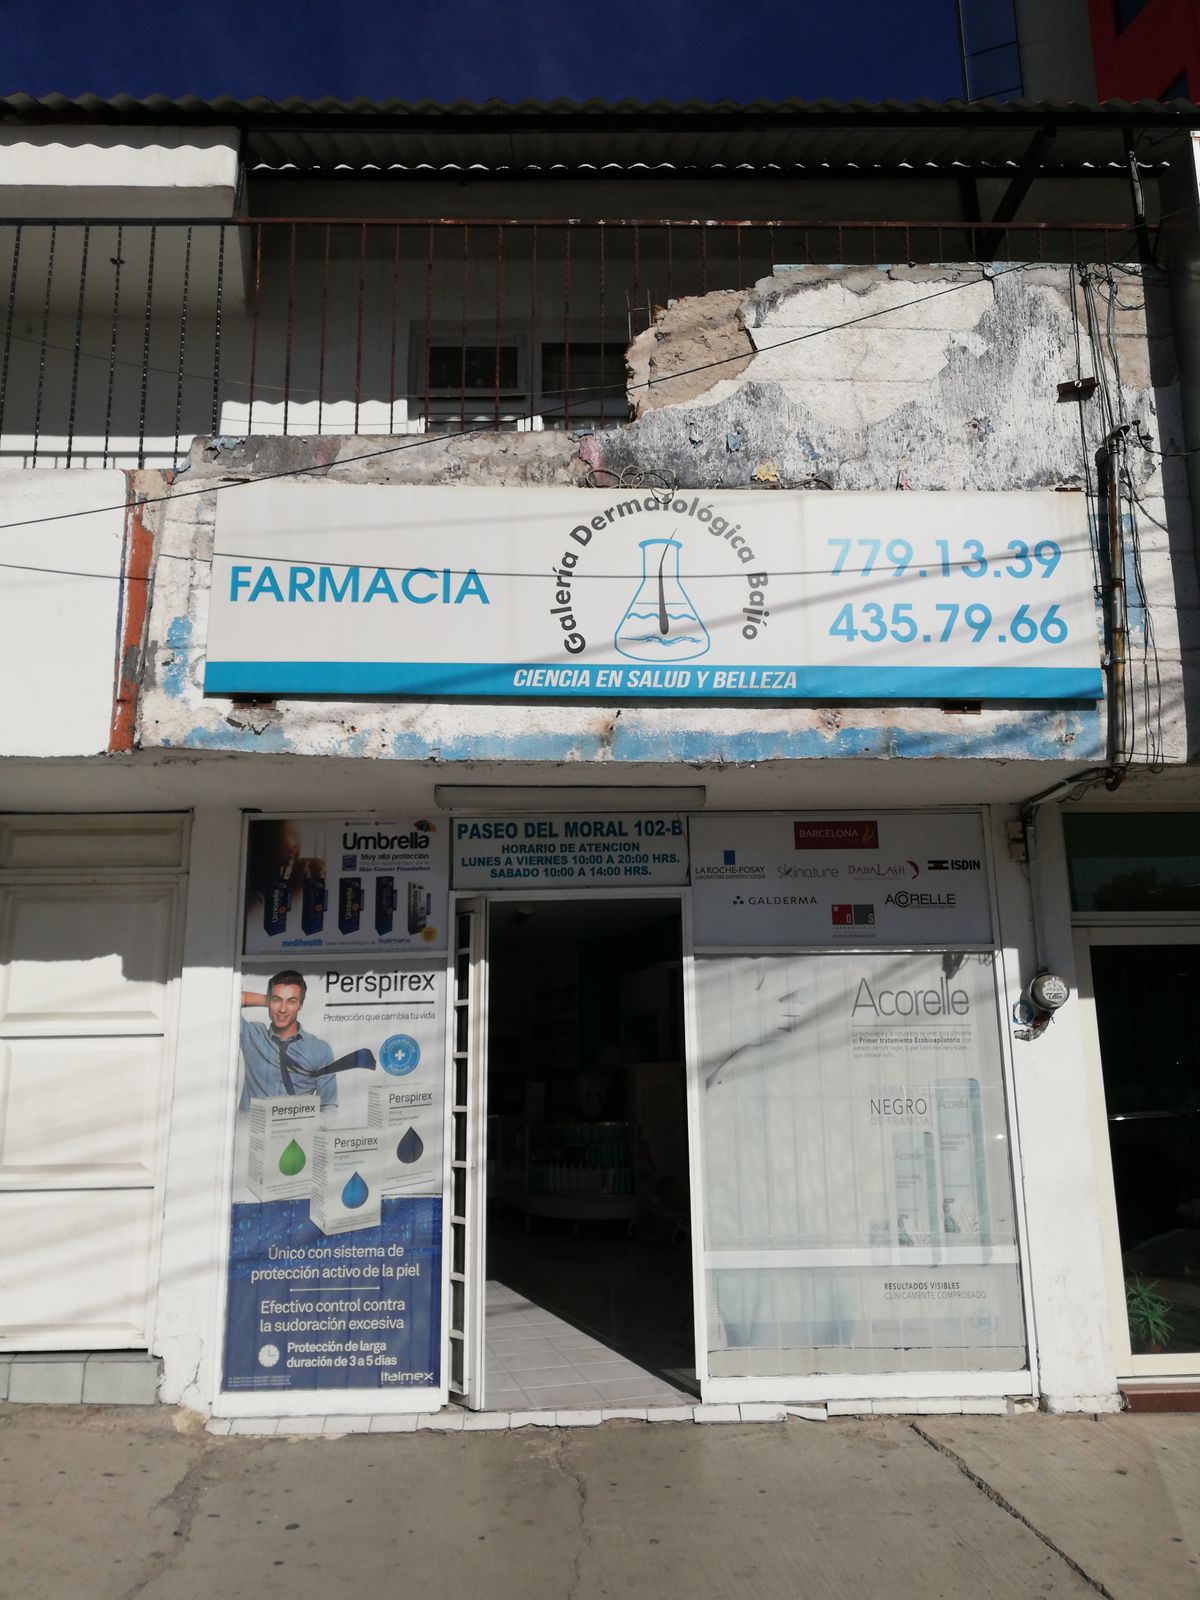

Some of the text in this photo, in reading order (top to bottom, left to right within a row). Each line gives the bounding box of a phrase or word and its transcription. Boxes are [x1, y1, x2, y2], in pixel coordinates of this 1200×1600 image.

[827, 538, 1062, 579] 779.13.39
[550, 494, 771, 655] Galería Dermatológica Bajío
[229, 566, 491, 604] FARMACIA
[828, 602, 1068, 644] 435.79.66
[513, 669, 797, 689] CIENCIA EN SALUD Y BELLEZA
[457, 820, 684, 839] PASEO DEL MORAL 102-B
[799, 829, 859, 838] BARCELONA
[342, 832, 430, 850] Umbrella
[501, 842, 640, 854] HORARIO DE ATENCION
[360, 853, 377, 861] Muy
[461, 853, 681, 867] LUNES A VIERNES 10:00 A 20:00 HRS.
[490, 866, 652, 878] SABADO 10:00 A 14:00 HRS.
[706, 866, 766, 874] ROCHE-POSAY
[951, 860, 981, 871] ISDIN
[748, 896, 817, 905] GALDERMA
[325, 970, 435, 998] Perspirex
[851, 976, 970, 1017] Acorelle
[323, 1011, 435, 1023] Protección que cambia tu vida
[859, 1036, 878, 1044] Primer
[879, 1036, 913, 1044] tratamiento
[389, 1091, 432, 1104] Perspirex
[271, 1104, 315, 1117] Perspirex
[870, 1098, 927, 1115] NEGRO
[334, 1136, 378, 1149] Perspirex
[268, 1244, 404, 1260] Único con sistema de
[251, 1263, 420, 1284] protección activo de la piel
[884, 1281, 960, 1290] RESULTADOS VISIBLES
[261, 1299, 405, 1314] Efectivo control contra
[260, 1317, 404, 1332] la sudoración excesiva
[287, 1340, 387, 1354] Protección de larga
[286, 1356, 333, 1368] duración
[334, 1356, 348, 1367] de
[349, 1356, 356, 1367] 3
[357, 1358, 364, 1367] a
[366, 1356, 373, 1366] 5
